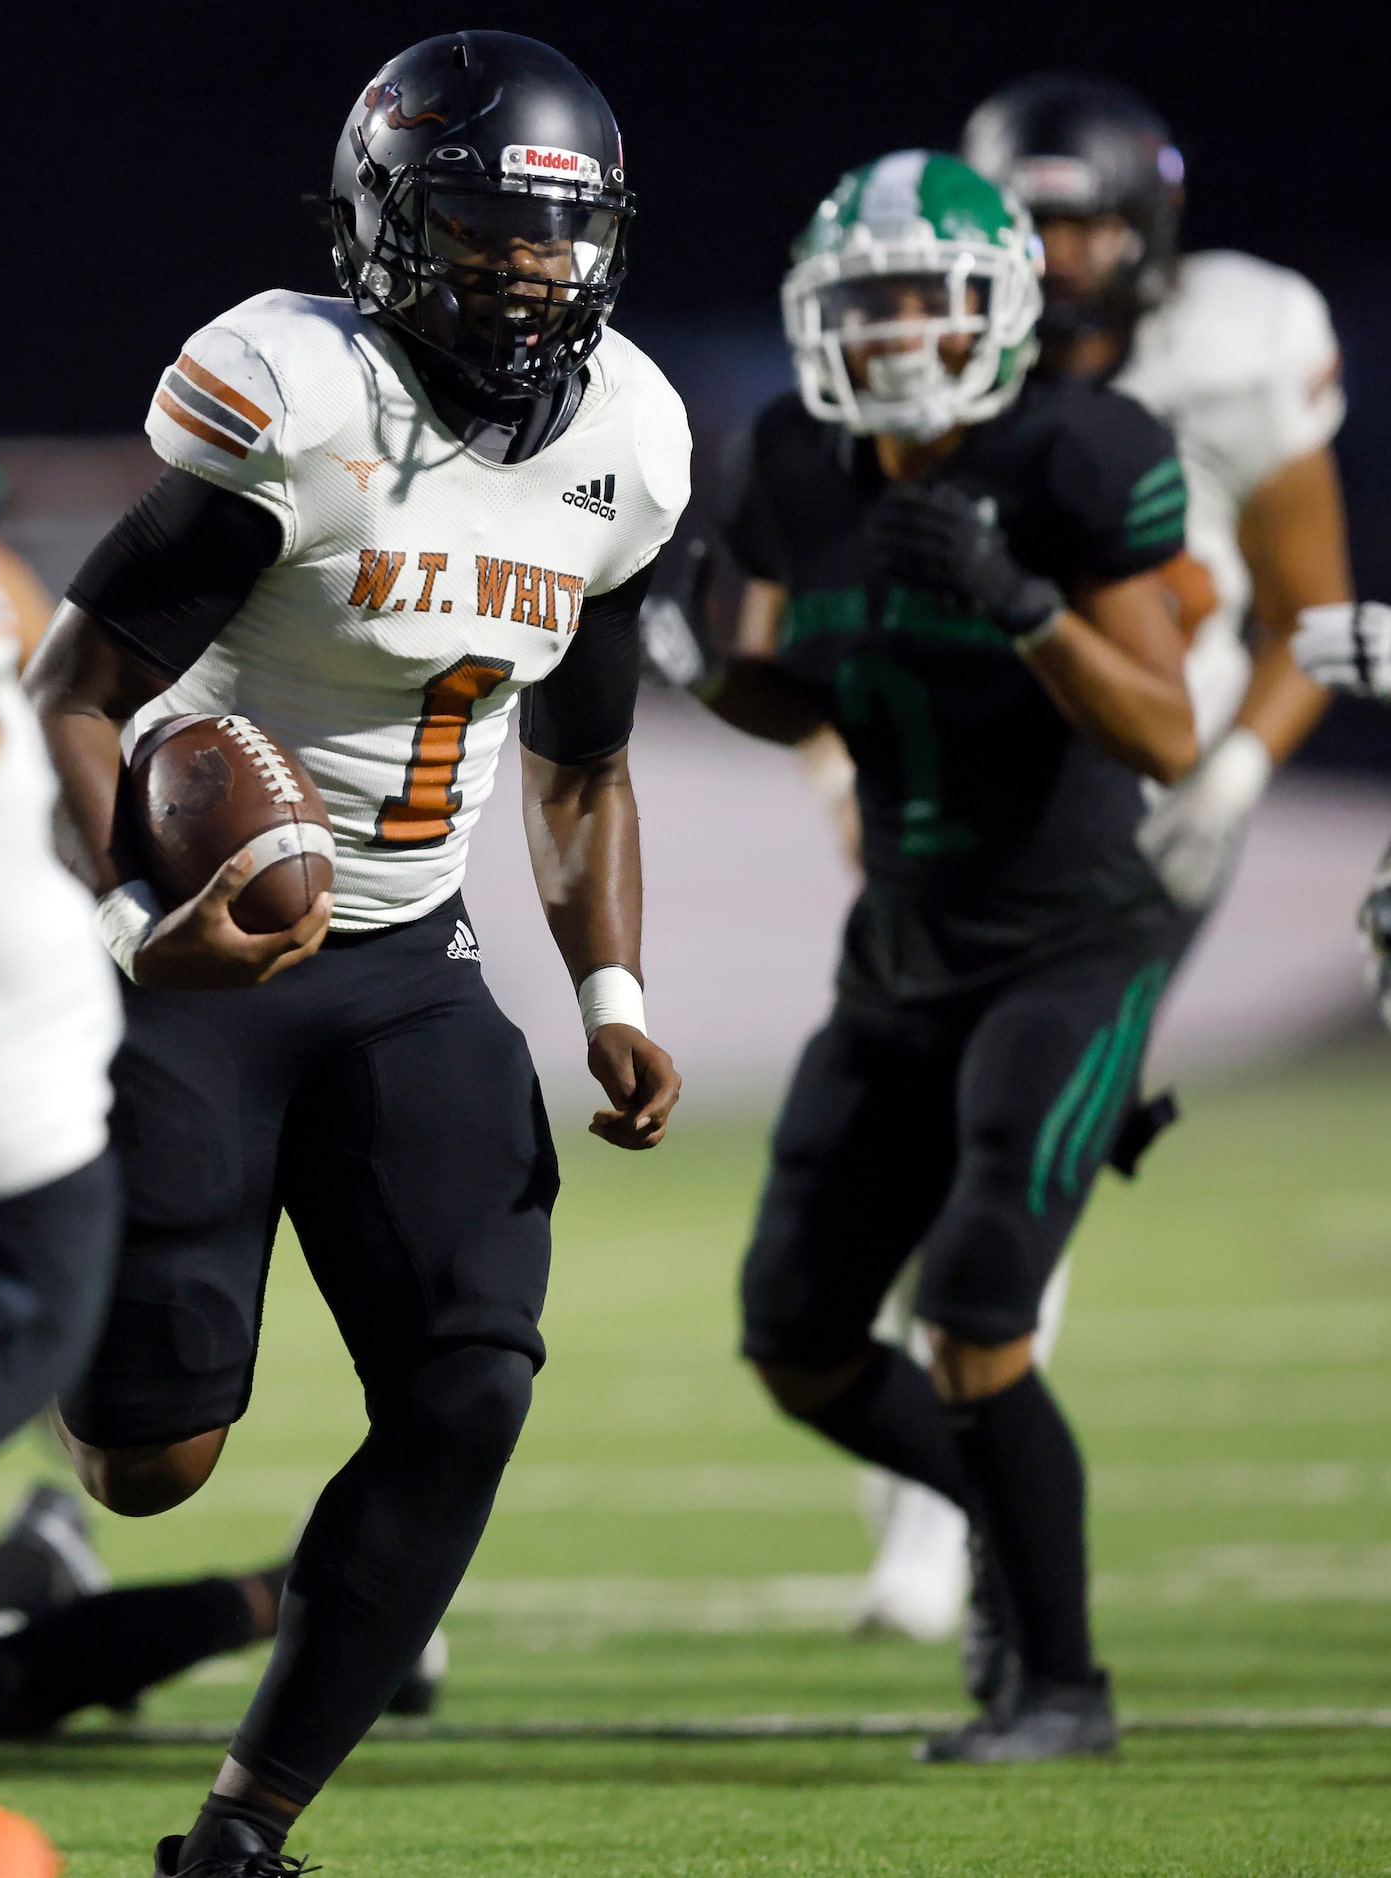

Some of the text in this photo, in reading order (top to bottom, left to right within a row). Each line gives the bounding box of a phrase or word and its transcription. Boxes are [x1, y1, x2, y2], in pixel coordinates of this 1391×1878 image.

[525, 149, 579, 171] Riddell
[562, 491, 616, 521] adidas
[347, 549, 585, 636] W.T. WHIT
[365, 654, 515, 850] 1
